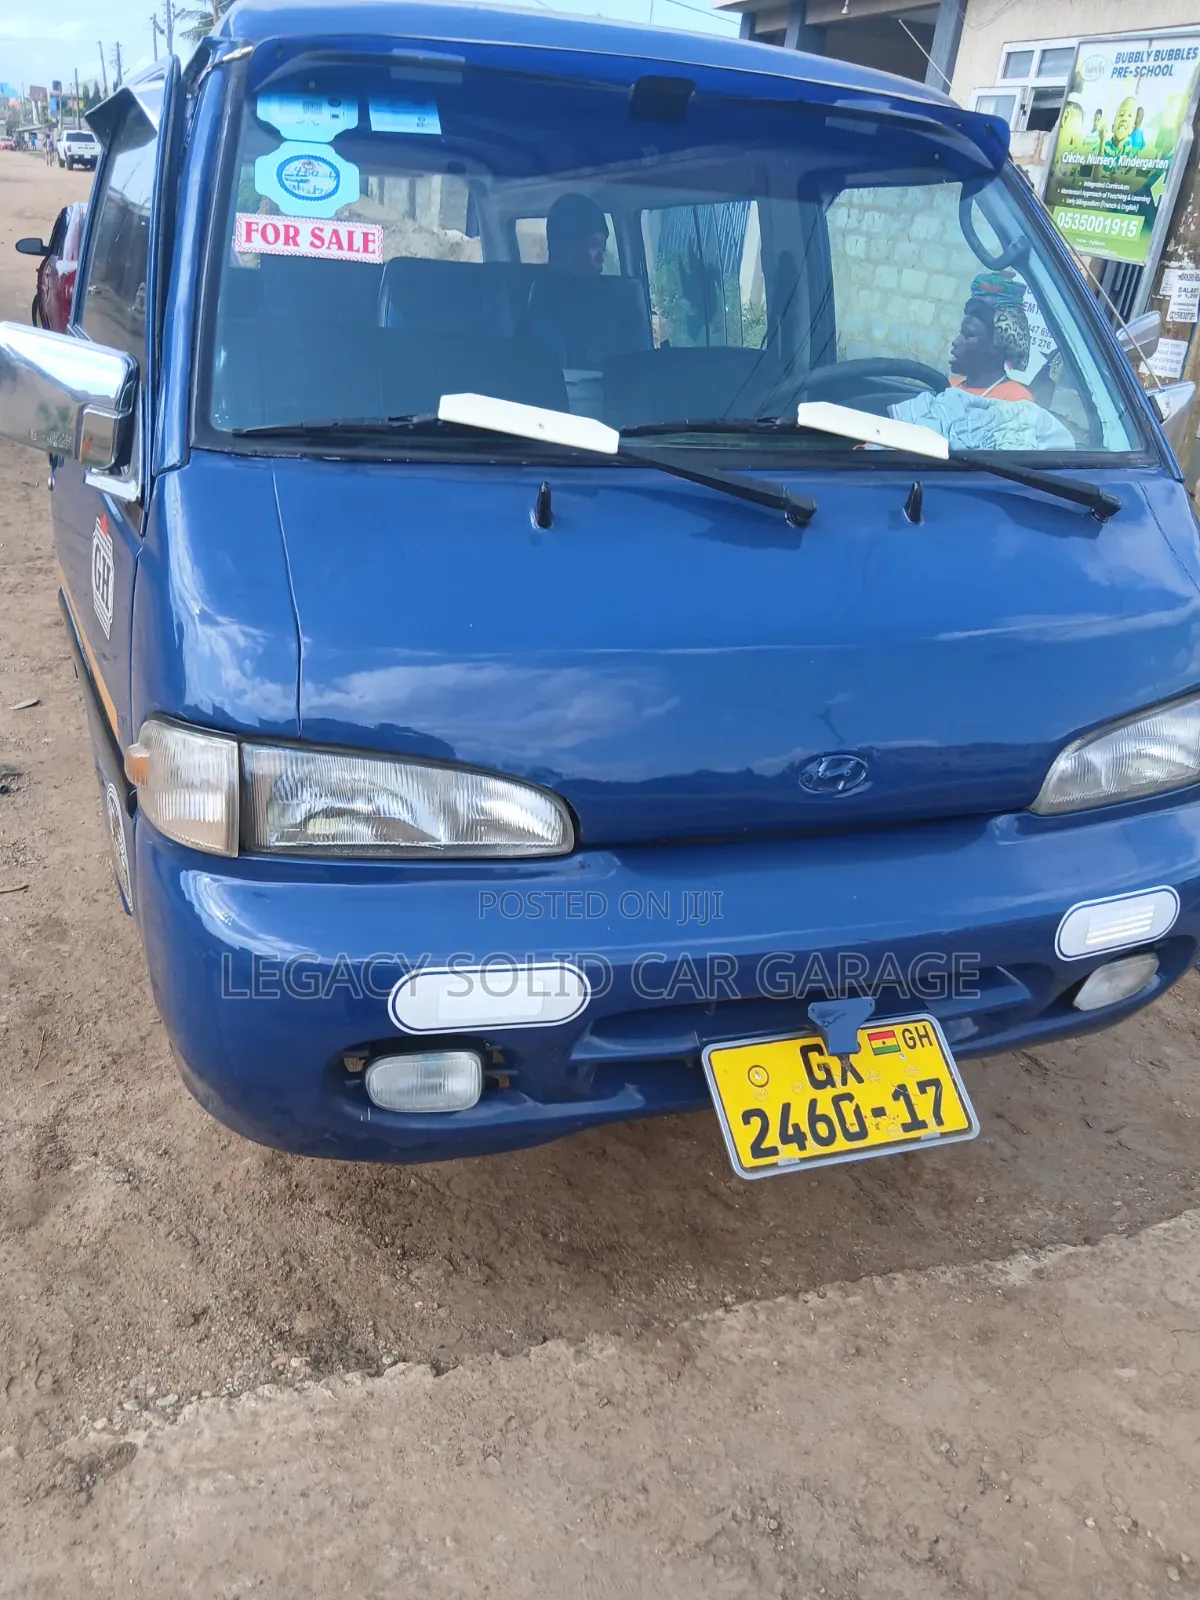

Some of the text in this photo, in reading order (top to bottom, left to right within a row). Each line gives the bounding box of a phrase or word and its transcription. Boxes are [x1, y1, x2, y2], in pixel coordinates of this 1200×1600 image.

[1115, 47, 1199, 64] BUBBLY BUBBLES
[1111, 64, 1174, 78] PRE-SCHOOL
[1087, 153, 1117, 168] Nursery,
[1118, 155, 1169, 170] Kindergarten
[1057, 212, 1138, 238] 0535001915
[244, 221, 376, 254] FOR SALE
[1038, 339, 1052, 350] 276
[902, 1025, 933, 1050] GH
[742, 1077, 944, 1159] 2460-17
